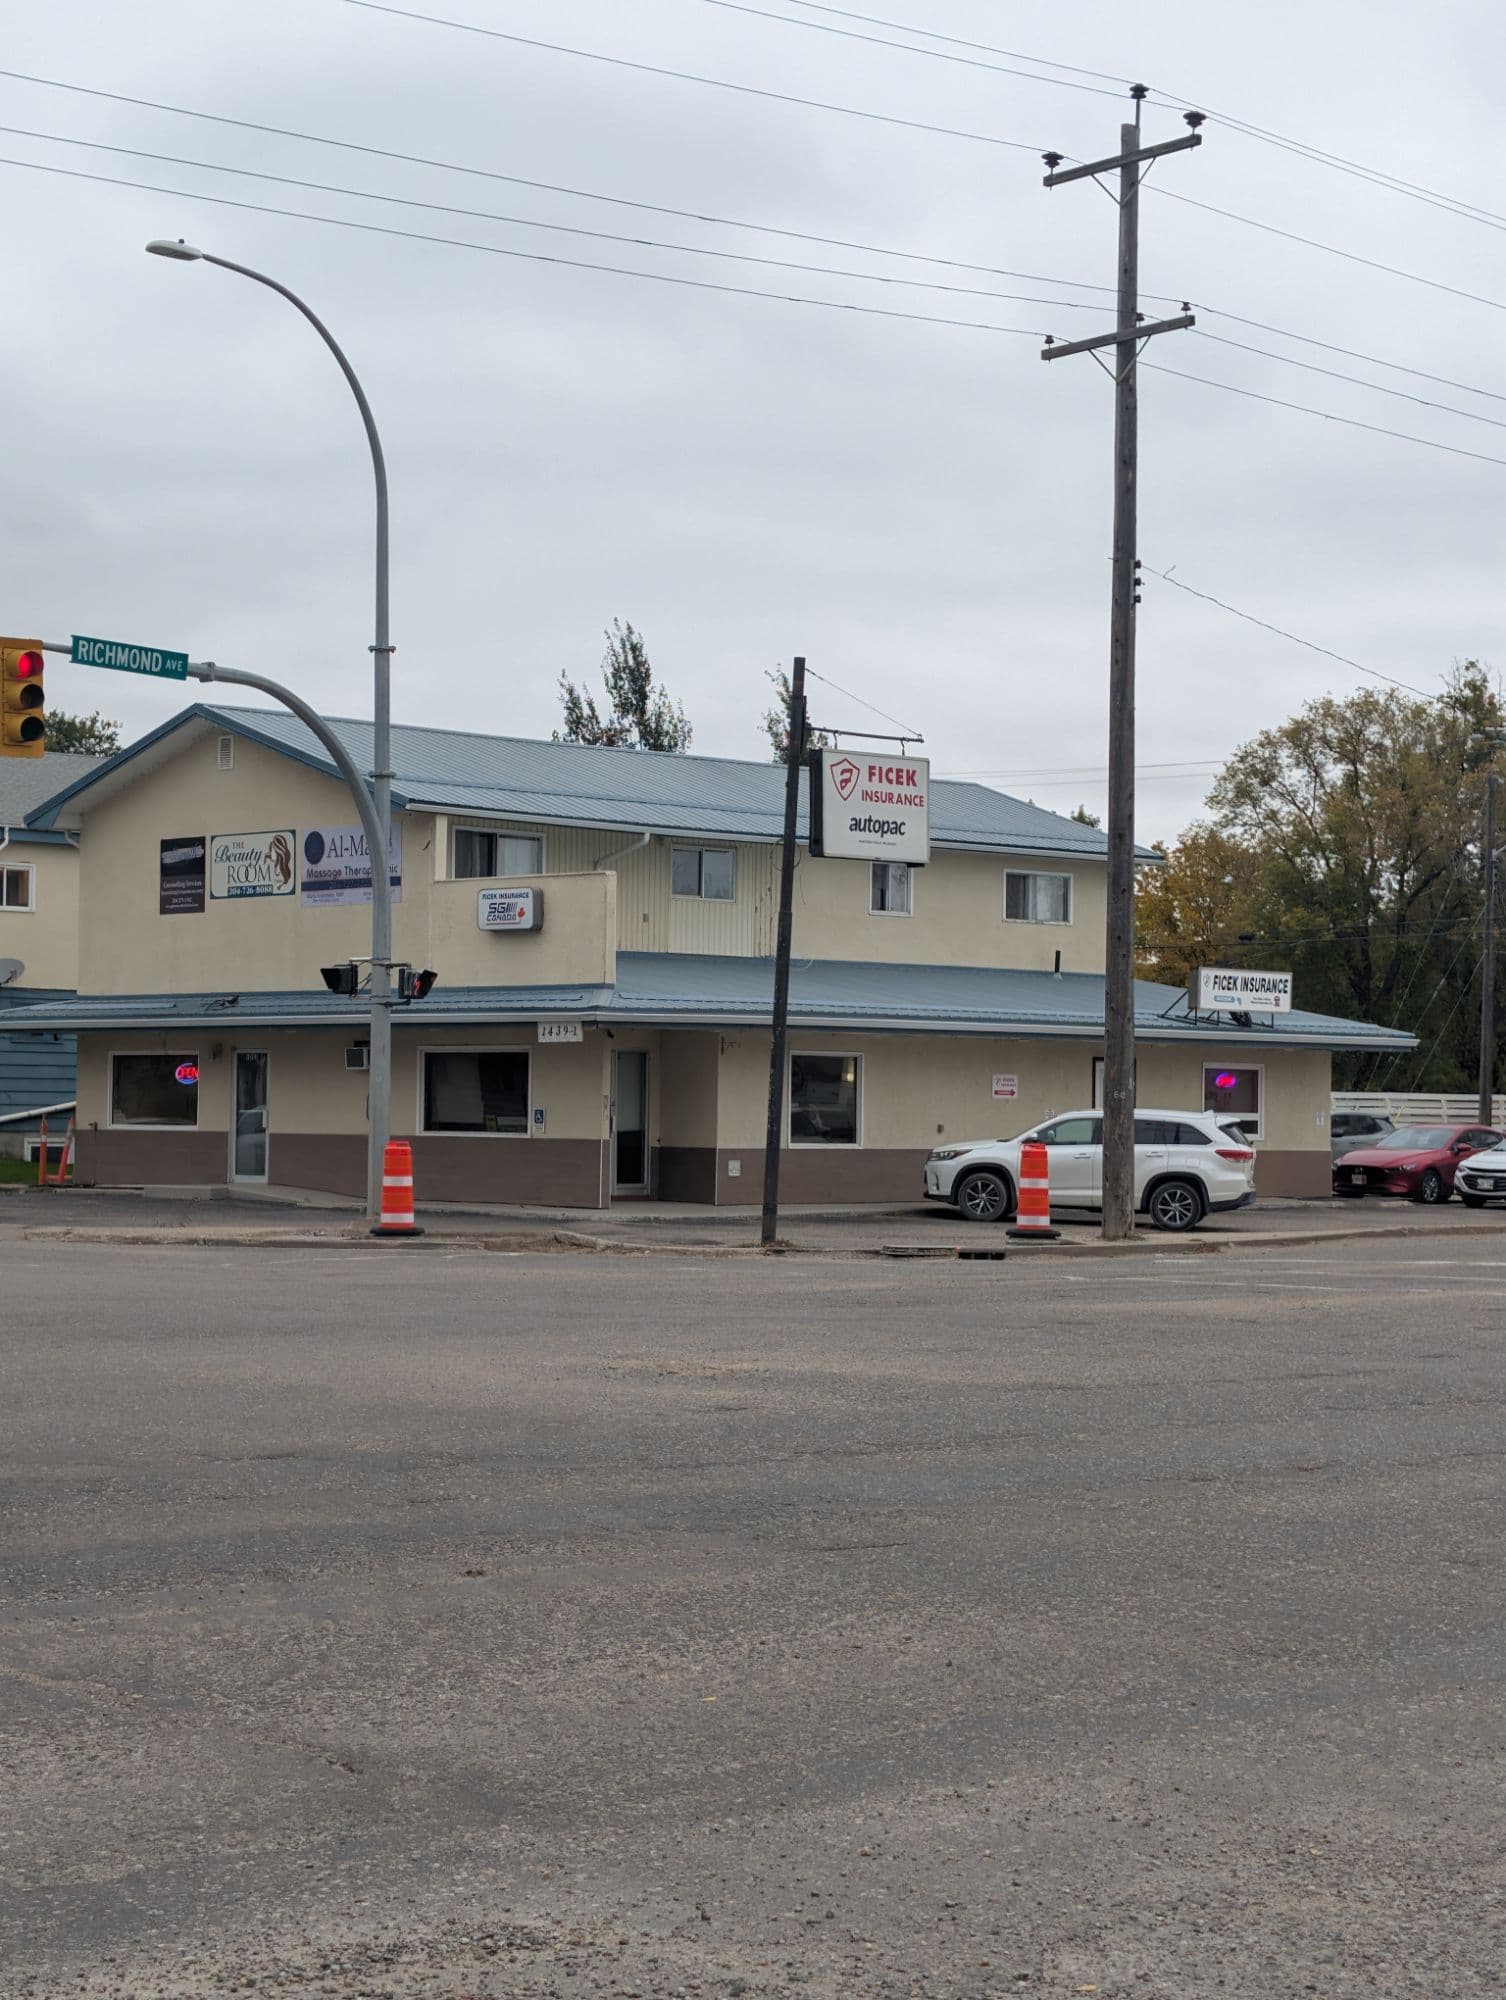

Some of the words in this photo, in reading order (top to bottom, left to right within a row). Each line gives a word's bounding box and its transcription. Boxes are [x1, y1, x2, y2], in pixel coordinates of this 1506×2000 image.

[78, 640, 162, 672] RICHMOND
[165, 659, 183, 671] AVE
[867, 765, 918, 787] FICEK
[861, 789, 925, 808] INSURANCE
[849, 814, 906, 838] autopac
[214, 844, 262, 866] Beauty
[227, 863, 272, 884] ROOM
[306, 867, 342, 878] Massage
[344, 865, 373, 877] Therap
[488, 902, 510, 914] SGI
[1212, 975, 1239, 991] FICEK
[1240, 976, 1289, 994] INSURANCE
